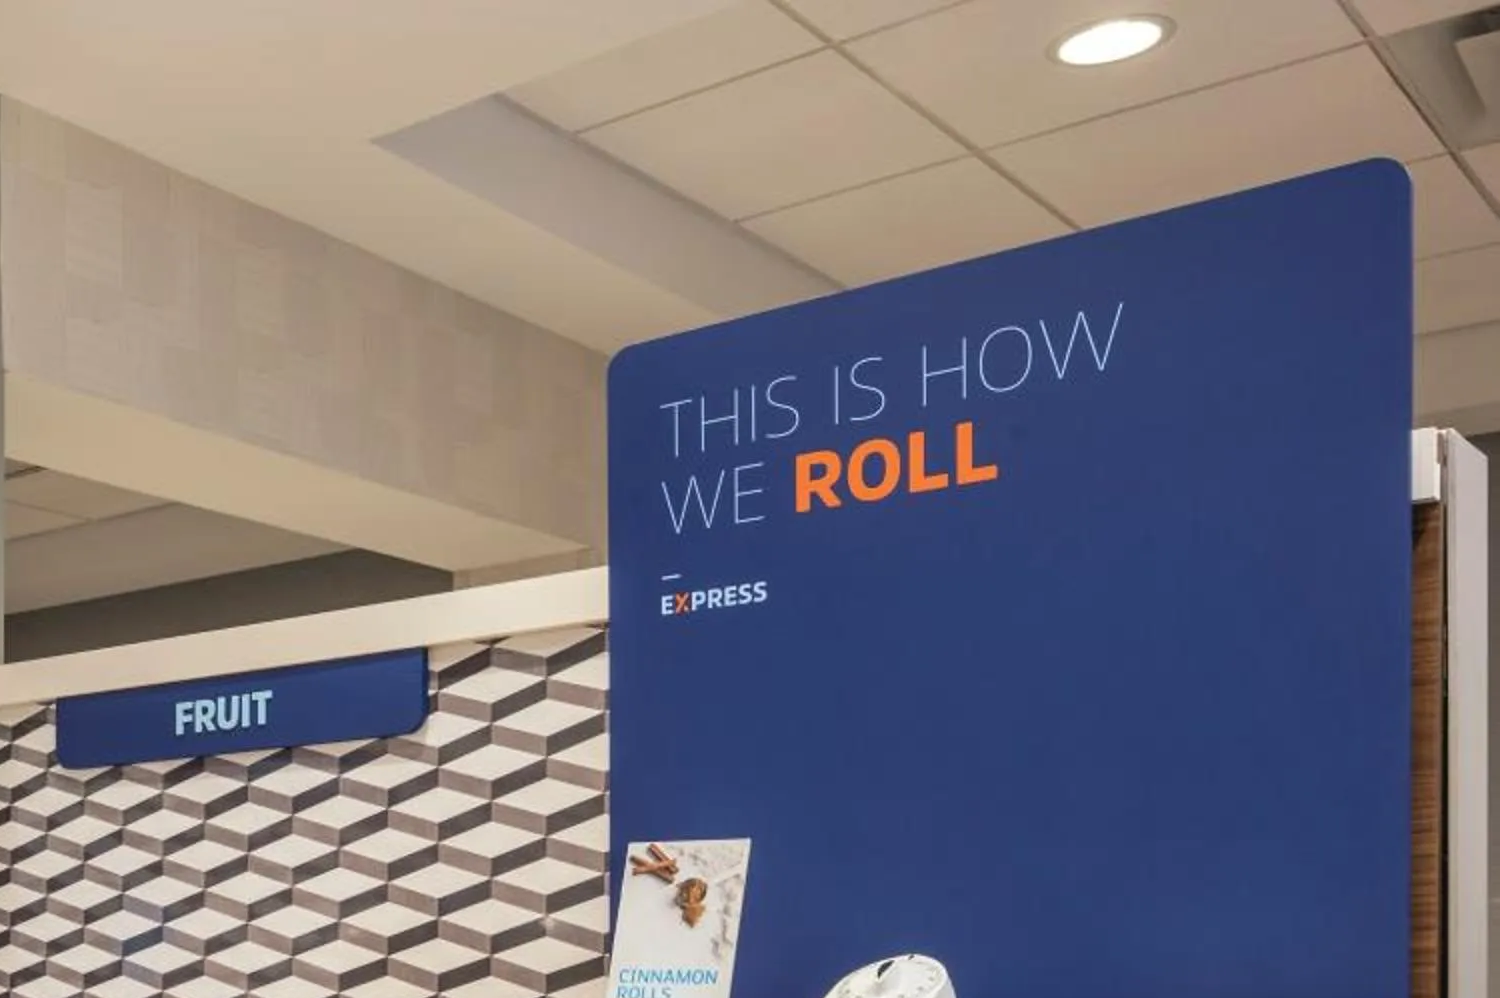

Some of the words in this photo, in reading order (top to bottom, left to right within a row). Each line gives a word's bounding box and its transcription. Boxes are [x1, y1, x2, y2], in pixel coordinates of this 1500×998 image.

[660, 376, 799, 457] THIS
[835, 357, 885, 424] IS
[923, 302, 1123, 406] HOW
[662, 462, 764, 534] WE
[796, 421, 998, 513] ROLL
[661, 581, 768, 616] EXPRESS
[175, 690, 273, 735] FRUIT
[619, 968, 719, 985] CINNAMON
